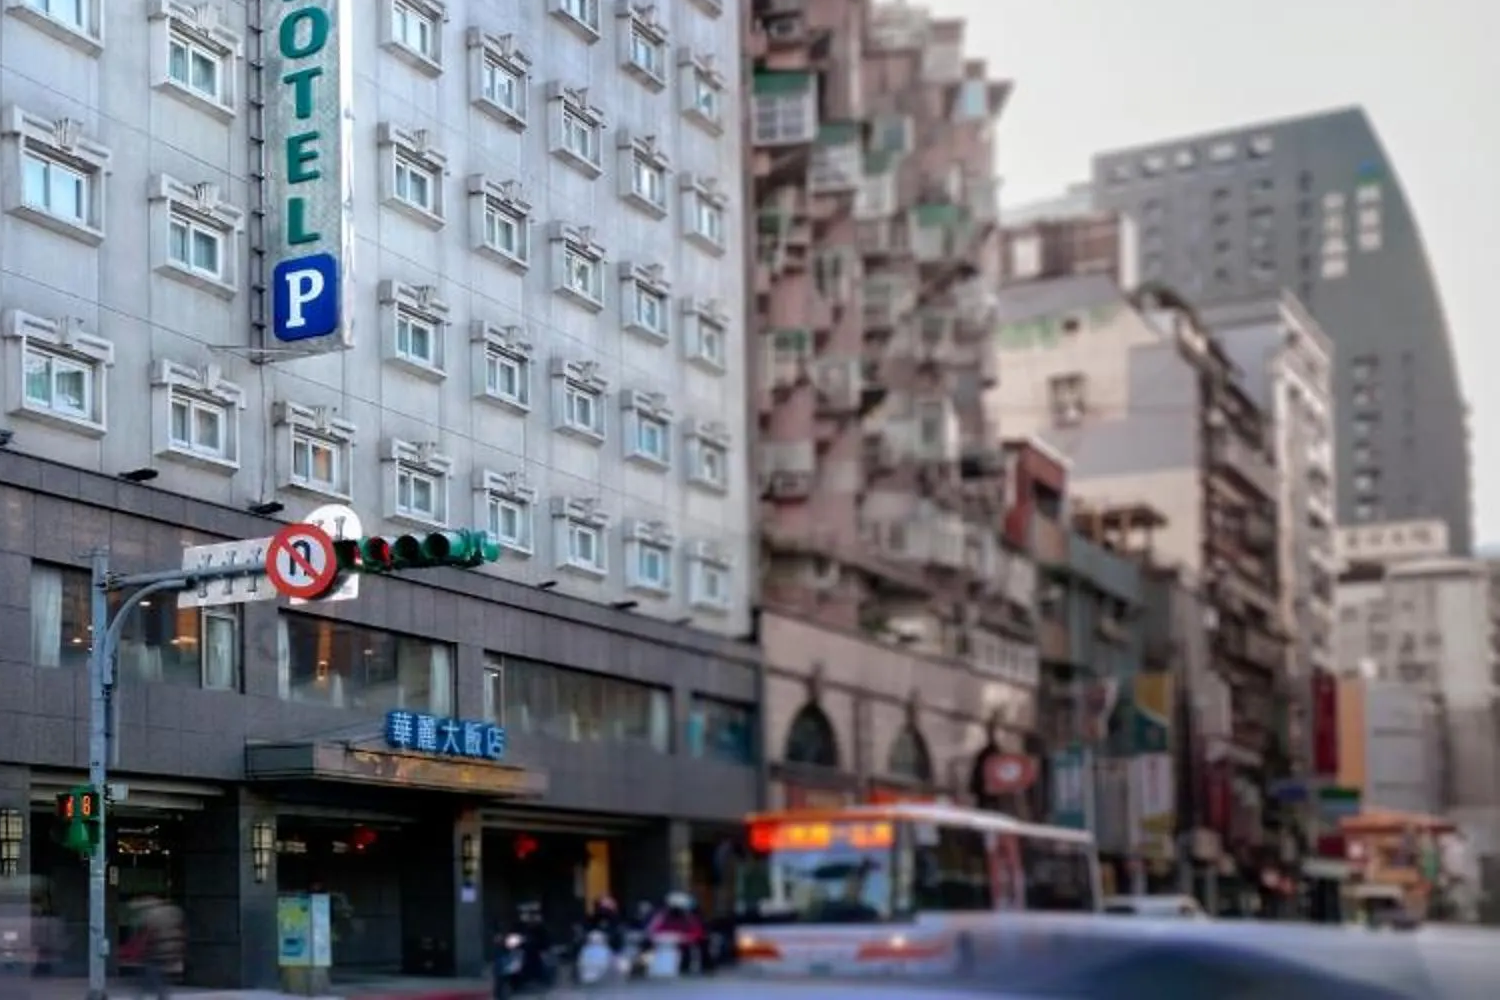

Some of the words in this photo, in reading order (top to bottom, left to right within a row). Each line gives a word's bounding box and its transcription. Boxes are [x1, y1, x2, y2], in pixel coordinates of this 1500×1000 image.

[285, 268, 325, 329] P
[390, 710, 506, 758] 華麗大飯店
